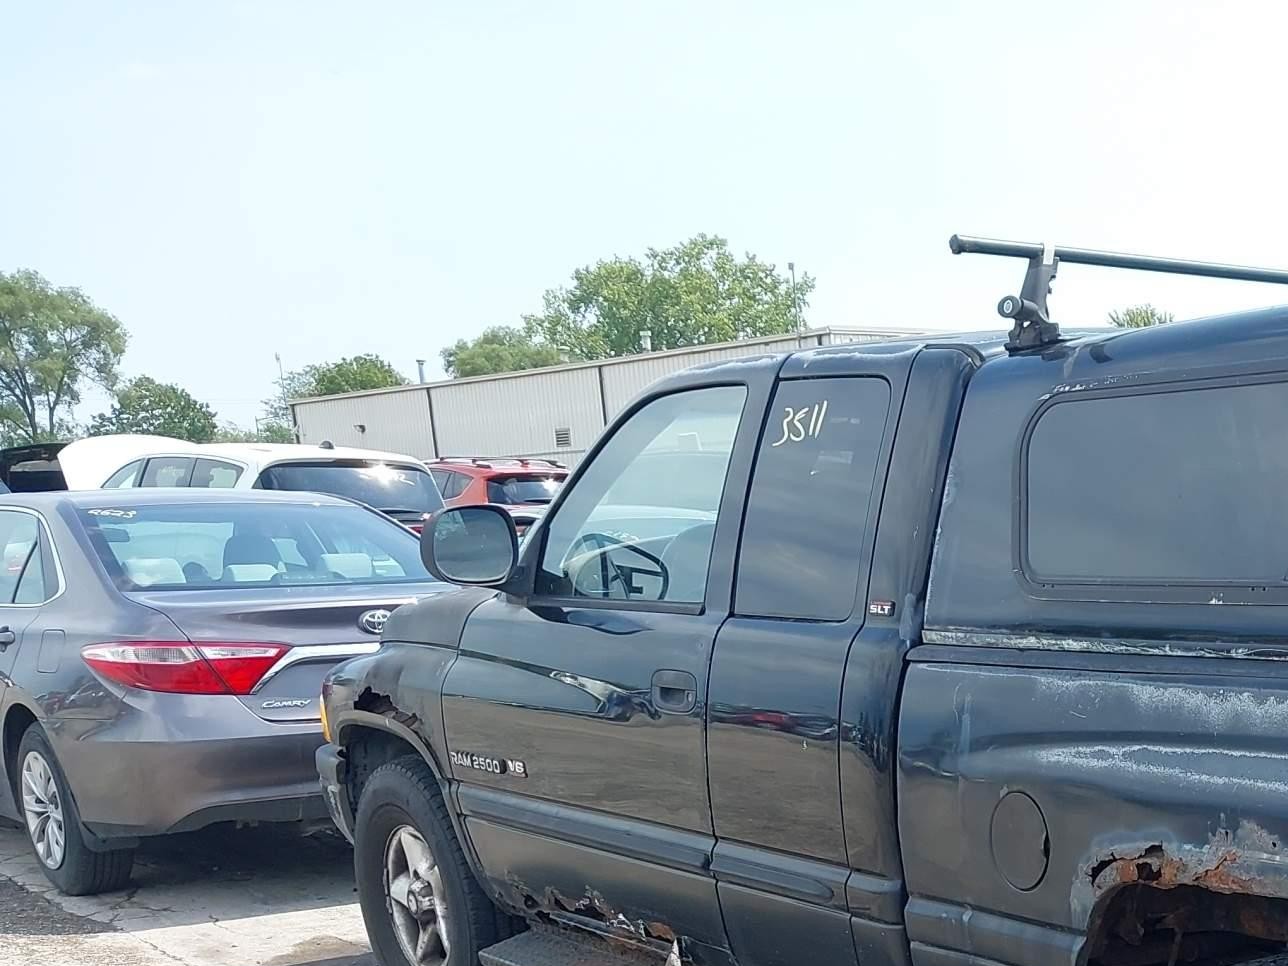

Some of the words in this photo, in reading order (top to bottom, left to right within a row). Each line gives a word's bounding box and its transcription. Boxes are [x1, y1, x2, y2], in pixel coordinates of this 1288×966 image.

[771, 400, 828, 447] 3511
[869, 604, 892, 615] SLT
[450, 751, 472, 768] RAM
[472, 756, 501, 774] 2500
